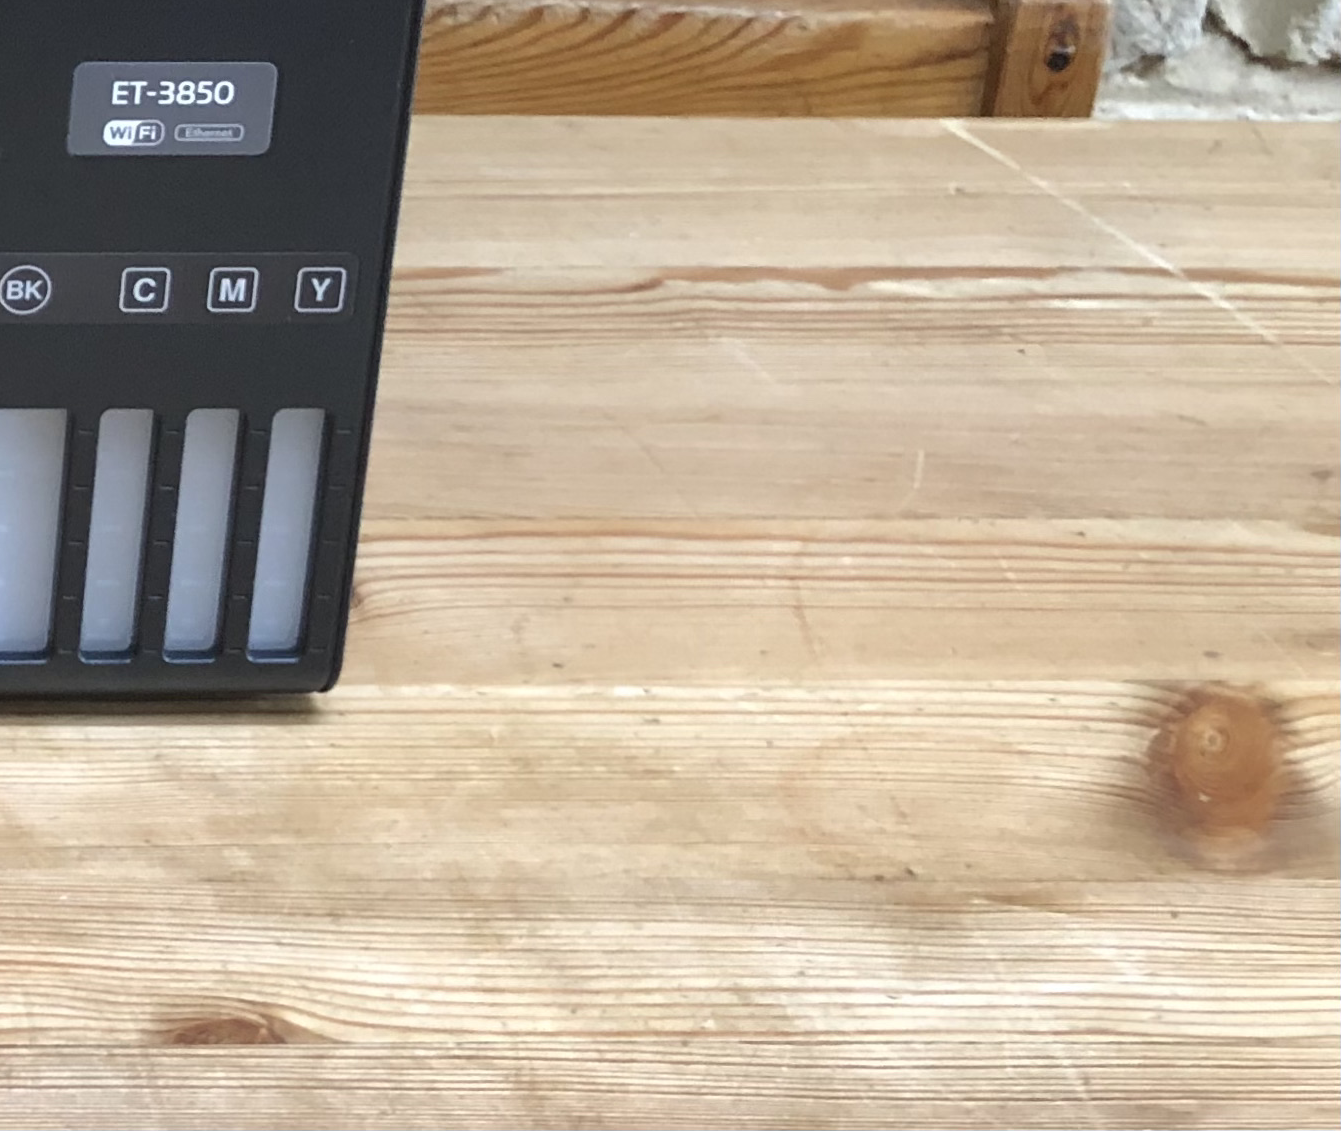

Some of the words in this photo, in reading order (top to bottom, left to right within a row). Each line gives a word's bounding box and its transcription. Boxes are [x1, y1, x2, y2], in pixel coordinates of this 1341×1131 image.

[111, 80, 235, 105] ET-3850
[5, 279, 44, 301] BK
[132, 277, 157, 302] C
[218, 278, 246, 302] M
[310, 278, 332, 301] Y
